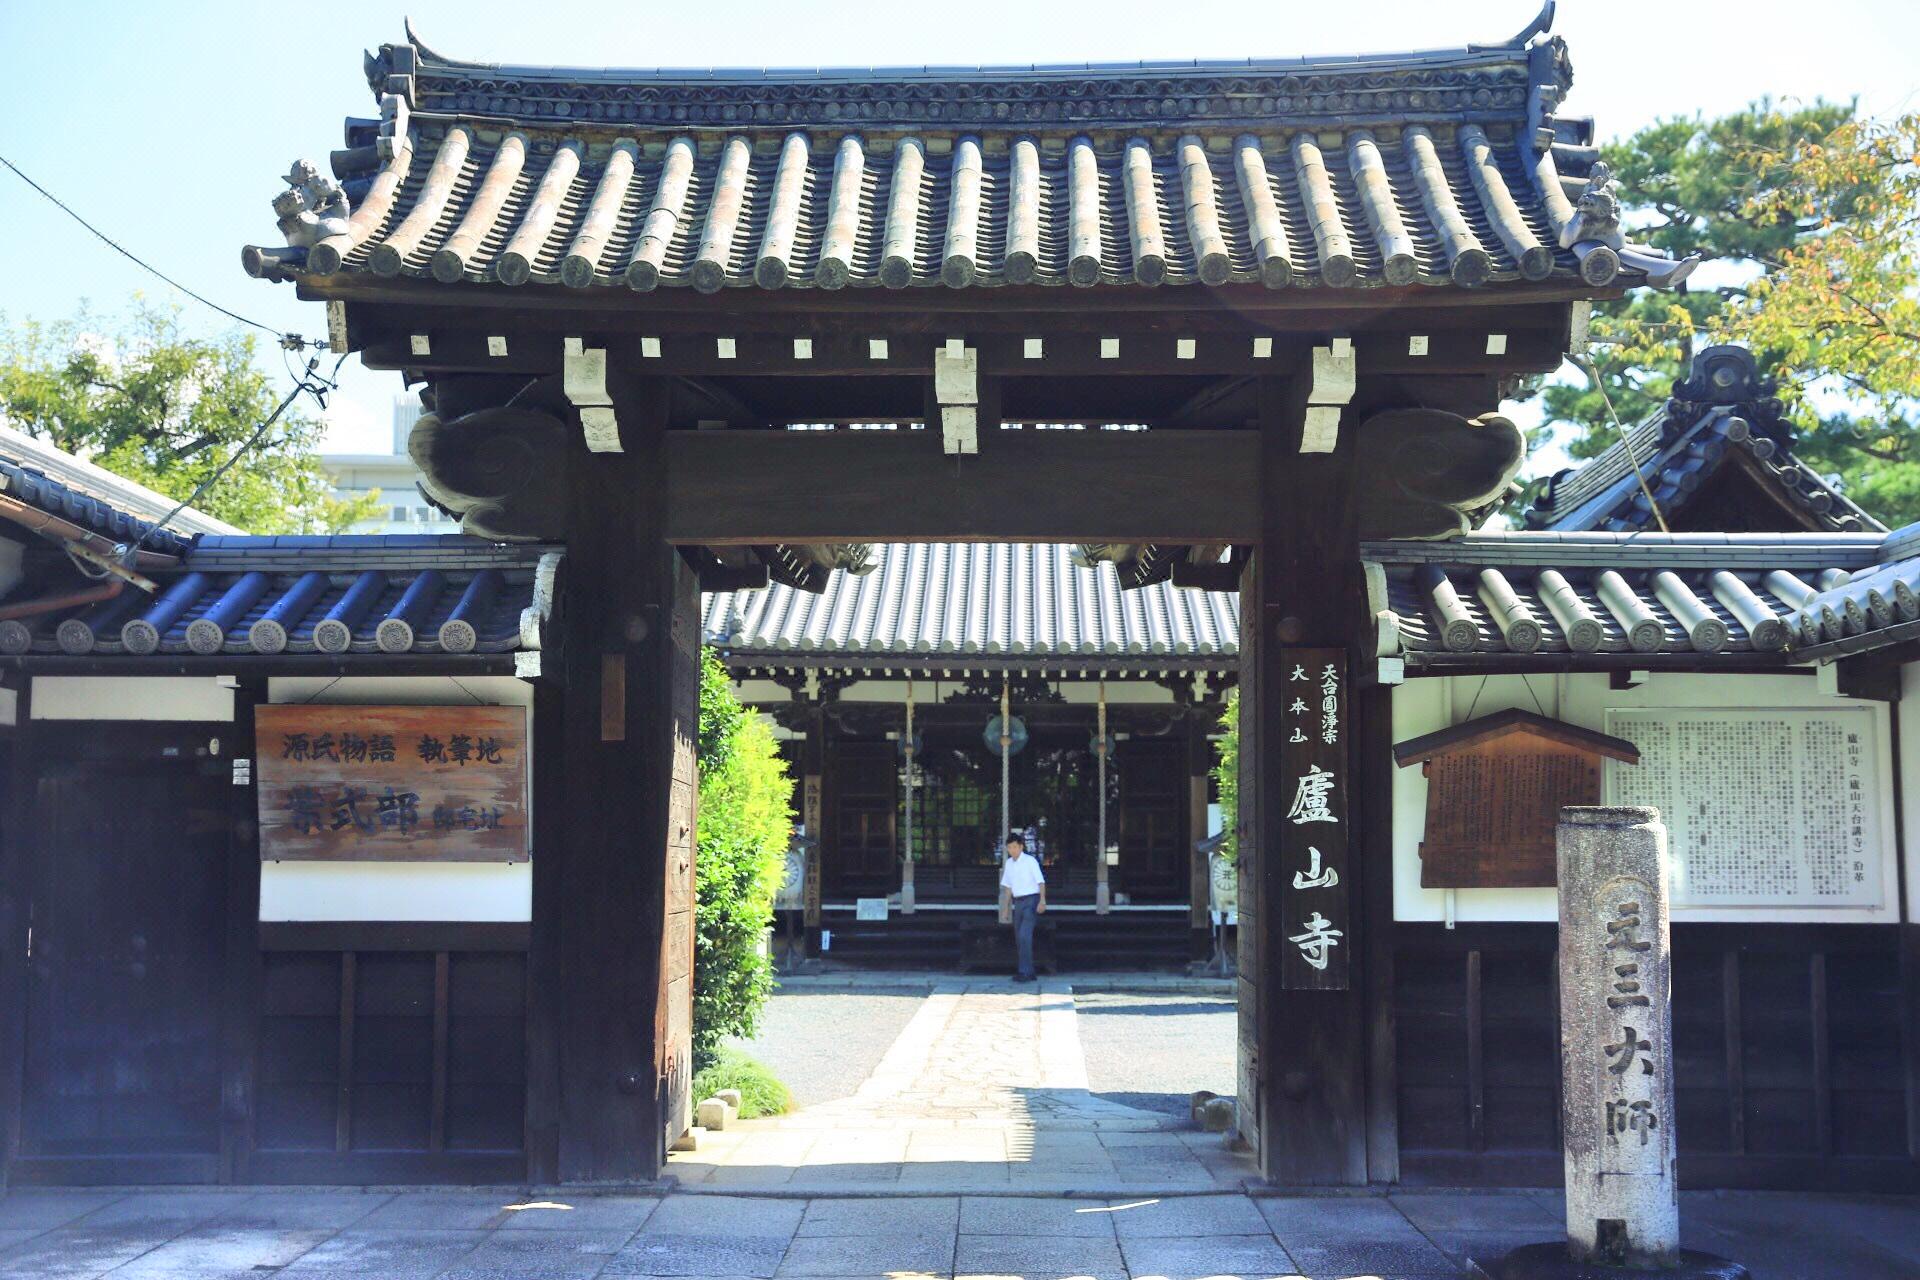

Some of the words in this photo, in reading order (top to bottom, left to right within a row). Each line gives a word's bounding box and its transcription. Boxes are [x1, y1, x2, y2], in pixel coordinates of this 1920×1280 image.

[283, 732, 396, 764] 源氏物語
[416, 733, 502, 766] 執筆地
[1289, 664, 1310, 743] 大本山
[1287, 764, 1343, 970] 廬山寺
[1603, 901, 1657, 1147] 元三大師
